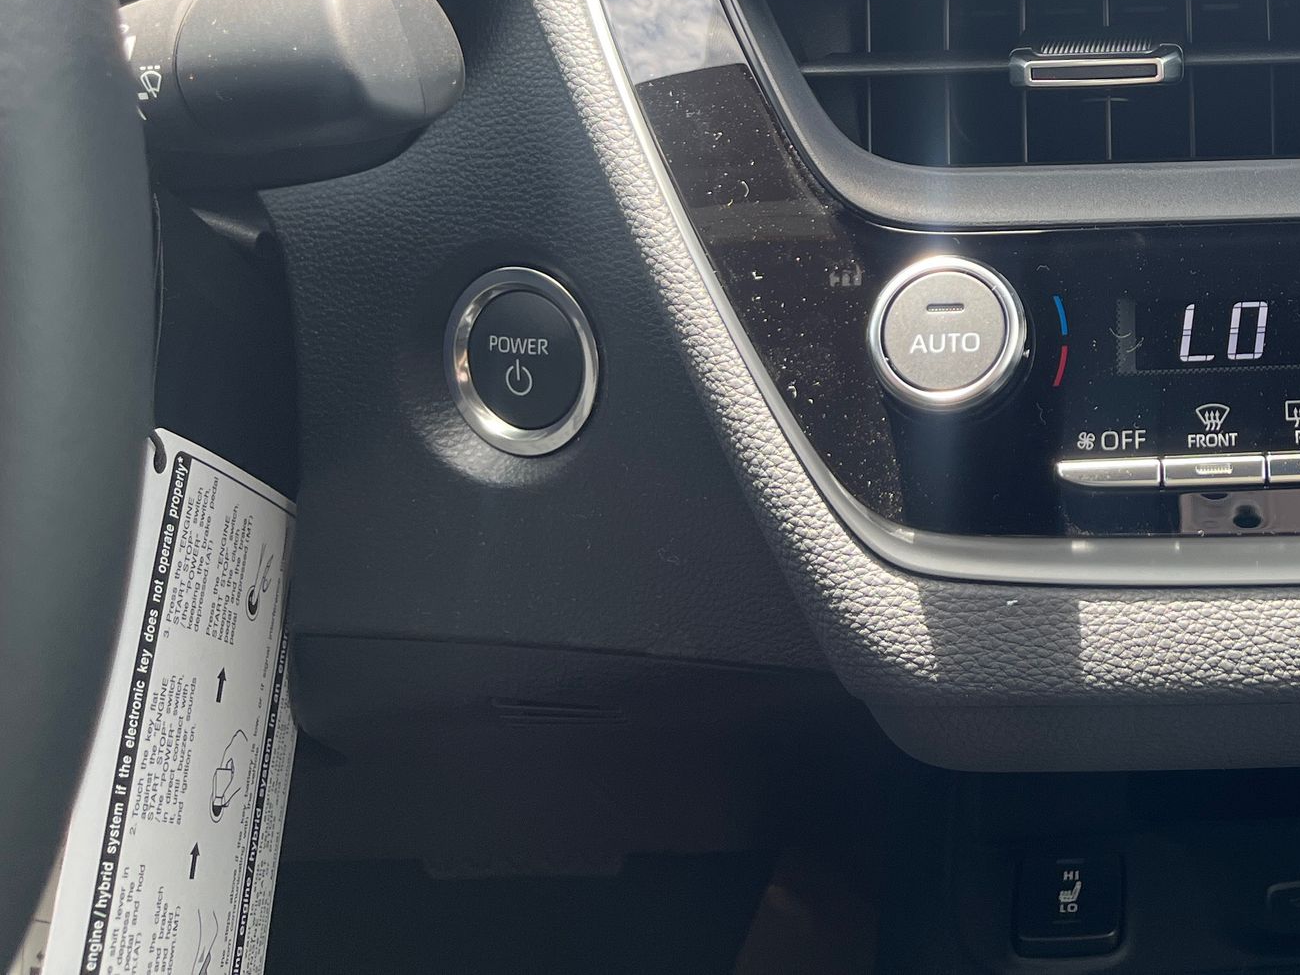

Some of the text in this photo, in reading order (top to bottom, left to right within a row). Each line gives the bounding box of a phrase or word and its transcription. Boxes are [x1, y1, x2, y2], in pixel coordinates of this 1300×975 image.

[909, 331, 980, 355] AUTO
[1179, 300, 1269, 363] LO
[489, 335, 549, 355] POWER
[1102, 430, 1147, 452] OFF
[1187, 432, 1239, 449] FRONT
[157, 524, 175, 574] operate
[151, 579, 164, 603] not
[143, 609, 159, 642] does
[136, 649, 153, 673] key
[124, 680, 145, 748] electronic
[118, 755, 132, 778] the
[115, 784, 127, 796] if
[106, 802, 125, 855] system
[1063, 870, 1080, 880] HI
[1059, 903, 1078, 913] LO
